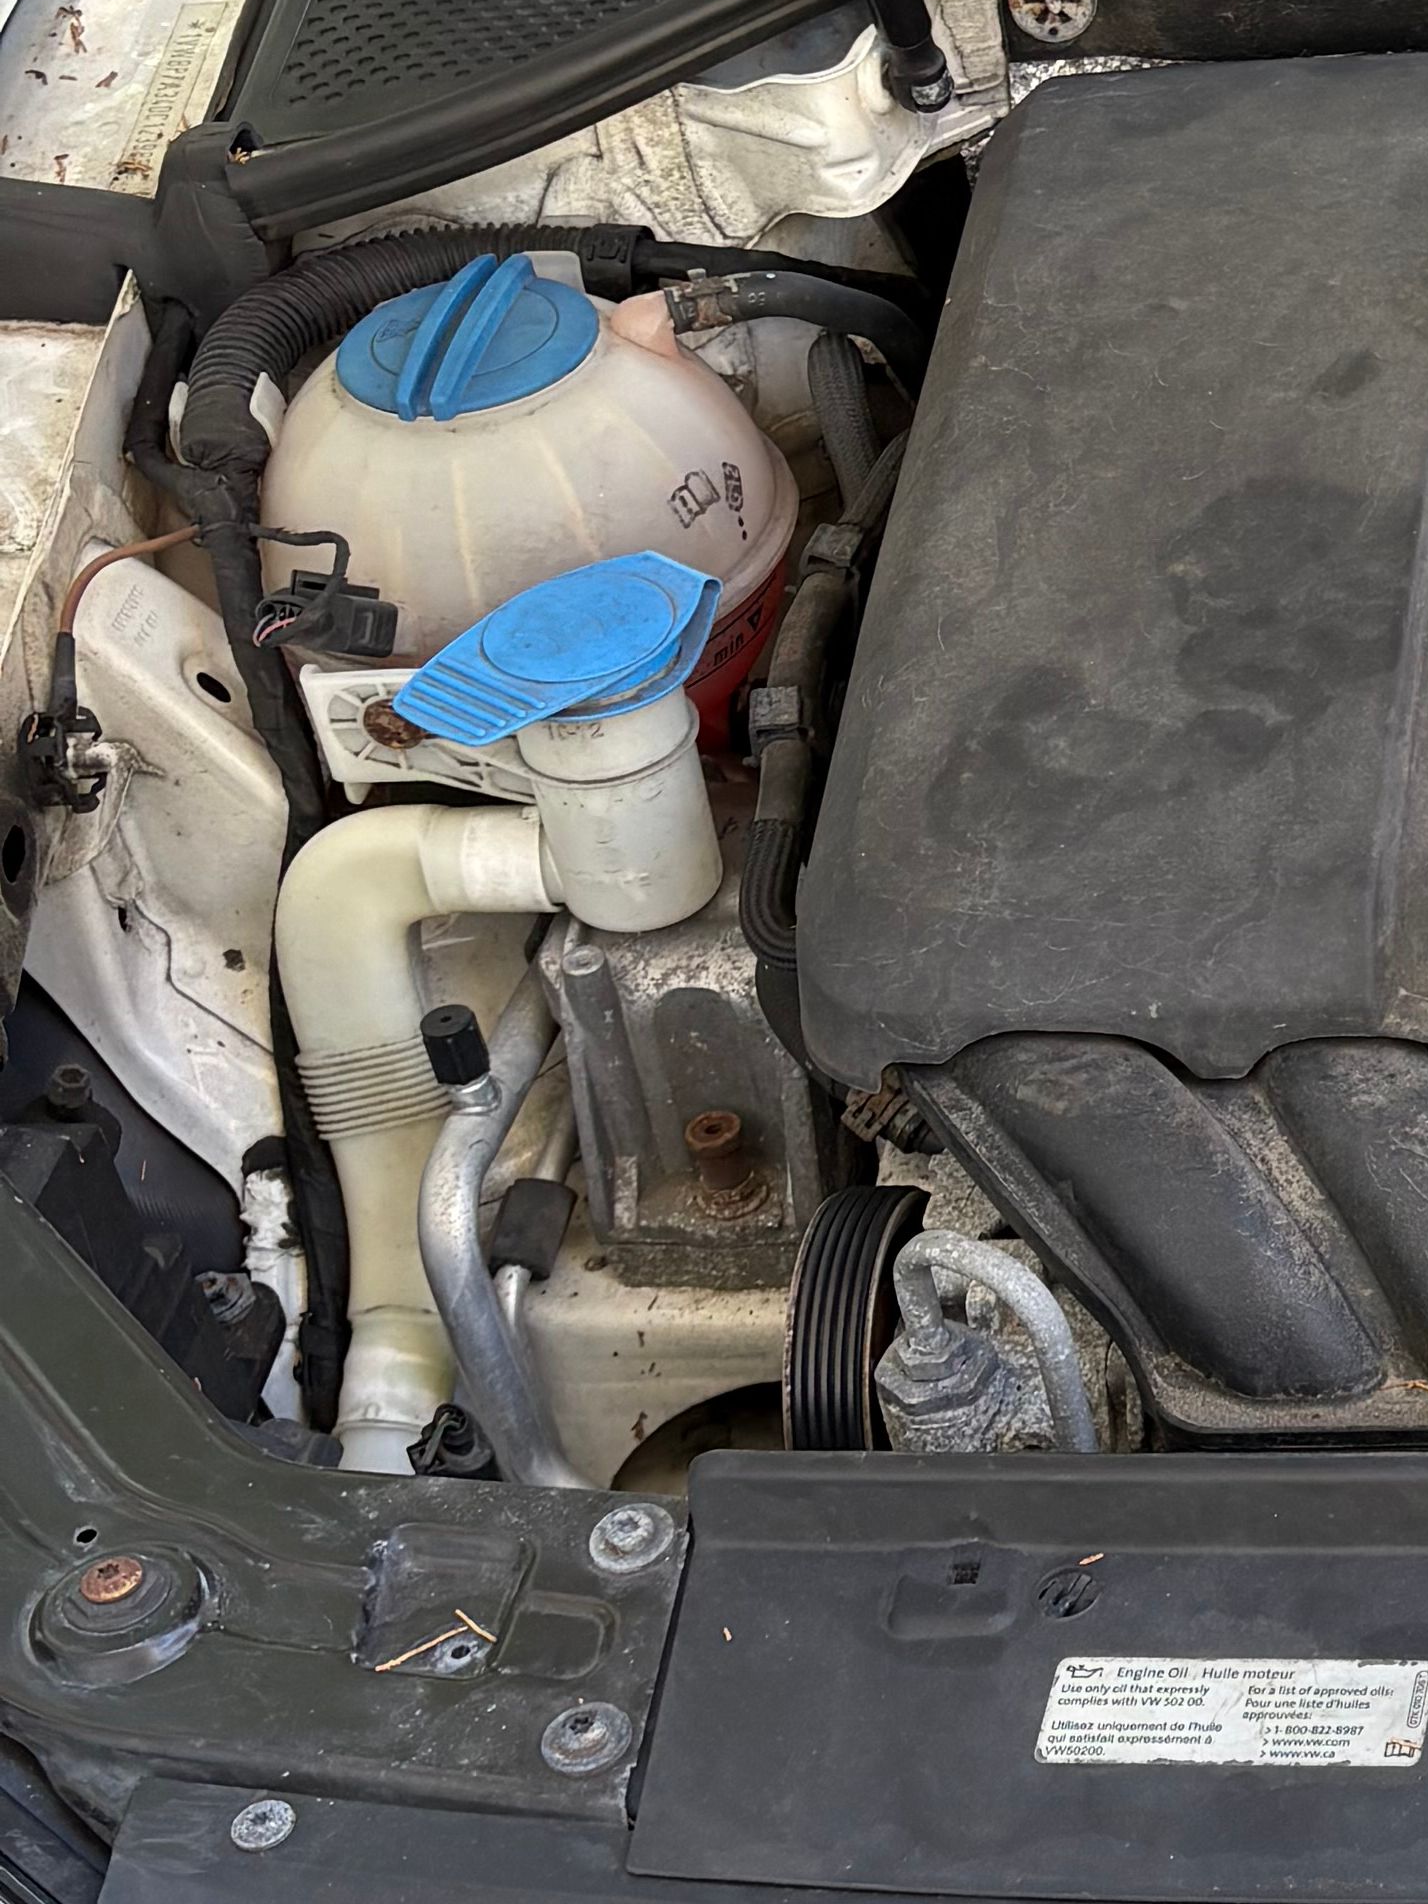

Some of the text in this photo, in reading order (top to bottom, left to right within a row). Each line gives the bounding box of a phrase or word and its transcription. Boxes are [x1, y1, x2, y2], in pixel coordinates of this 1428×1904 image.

[713, 633, 745, 666] min
[1117, 1667, 1164, 1681] Engine
[1168, 1667, 1188, 1679] Oil
[1242, 1669, 1295, 1680] moteur
[1061, 1685, 1209, 1696] Use only oil that expressly
[1248, 1686, 1267, 1695] For
[1279, 1686, 1296, 1695] list
[1299, 1686, 1312, 1695] of
[1314, 1687, 1367, 1697] approved
[1370, 1687, 1394, 1696] oils:
[1057, 1696, 1205, 1708] complies with VW 502 00.
[1245, 1699, 1271, 1708] Pour
[1299, 1700, 1322, 1708] liste
[1326, 1699, 1370, 1709] d'huiles
[1242, 1711, 1312, 1721] approuvées:
[1051, 1720, 1094, 1731] Utilisez
[1097, 1721, 1167, 1732] uniquement
[1170, 1721, 1185, 1731] de
[1047, 1734, 1065, 1745] qui
[1117, 1735, 1201, 1746] expressément
